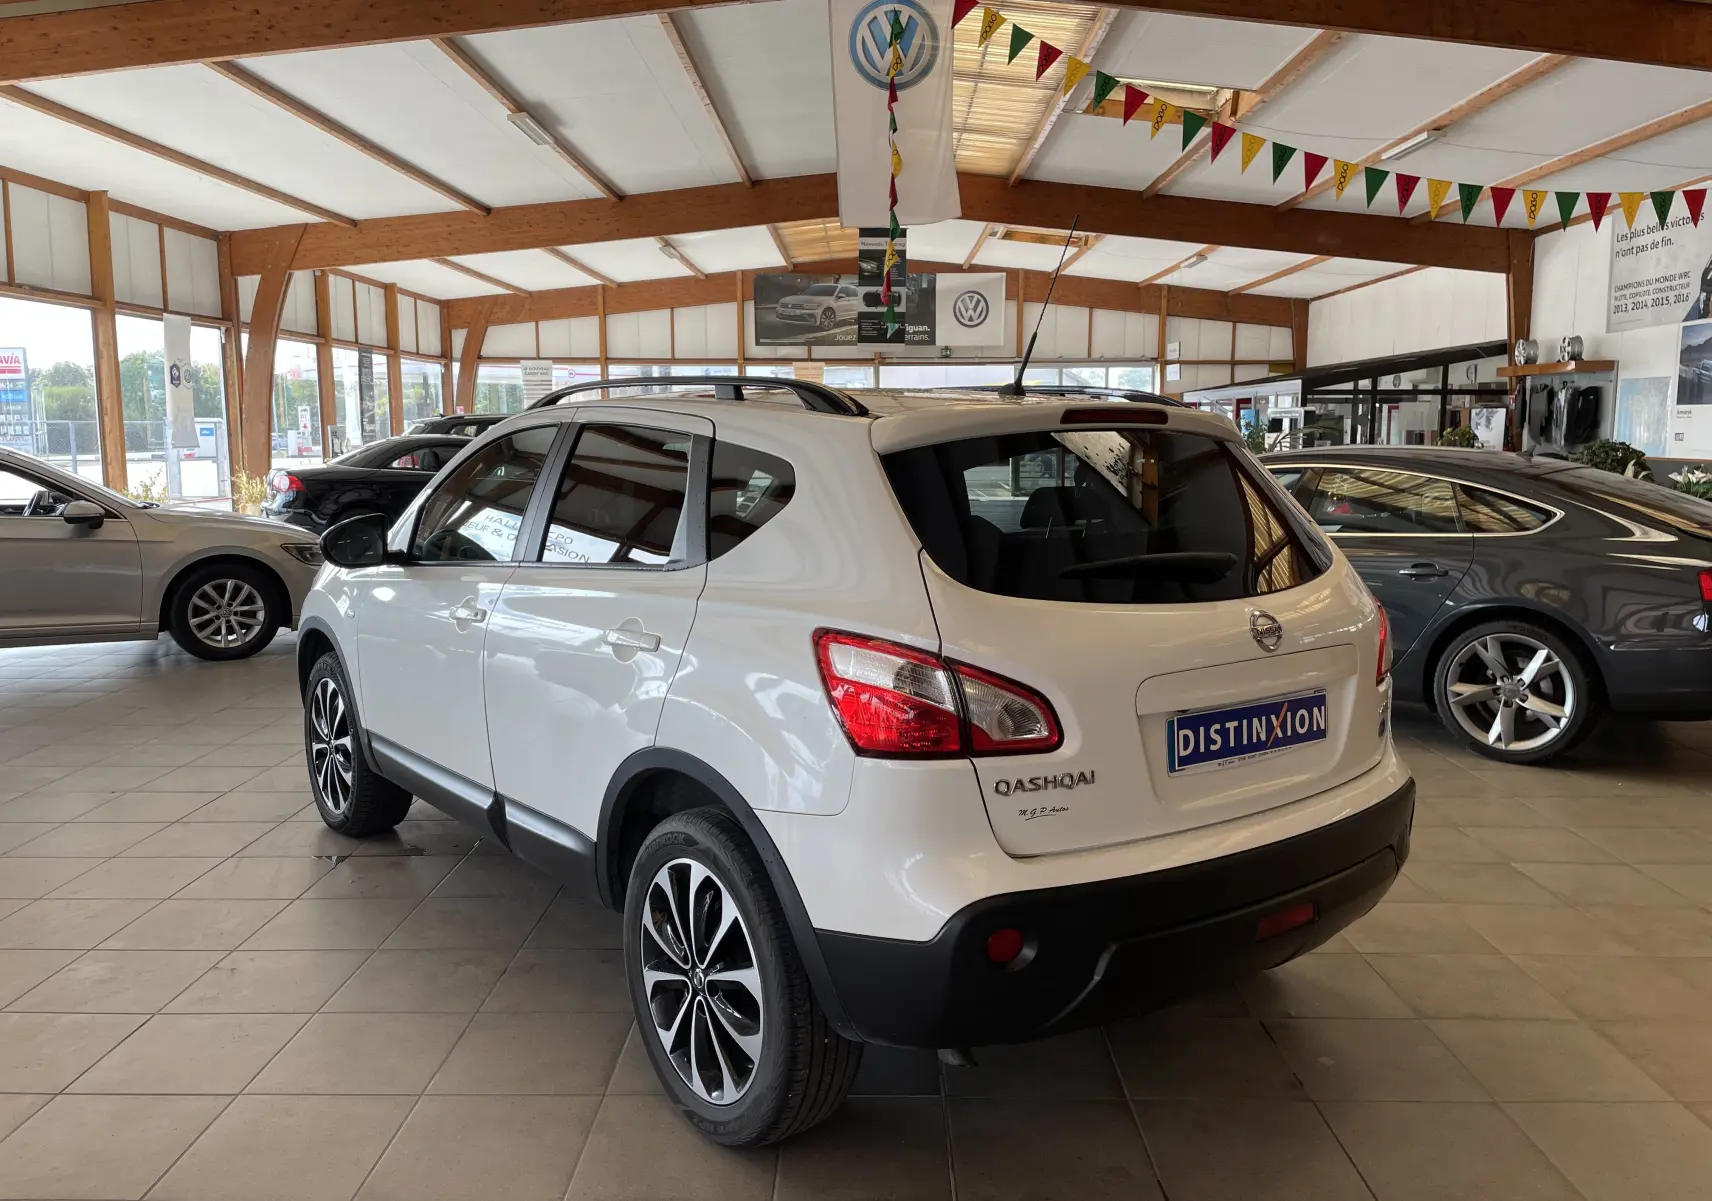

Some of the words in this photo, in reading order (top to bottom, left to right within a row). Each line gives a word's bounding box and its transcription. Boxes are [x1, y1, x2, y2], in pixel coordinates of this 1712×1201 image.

[1153, 103, 1168, 131] DOBO
[1337, 163, 1349, 191] DOBO
[1529, 192, 1538, 220] DOBO
[1616, 232, 1629, 243] Les
[1629, 228, 1645, 243] plus
[1646, 221, 1669, 235] bells
[1670, 212, 1705, 229] victos
[1635, 242, 1649, 256] pas
[1650, 239, 1660, 250] de
[1661, 236, 1675, 248] fin.
[1614, 281, 1645, 293] CHAMPIONS
[1646, 278, 1654, 287] DU
[1655, 273, 1677, 284] MONDE
[1677, 270, 1691, 280] WRC
[1652, 282, 1691, 295] CONSTRUCTEUR
[1613, 303, 1630, 315] 2013,
[1651, 296, 1672, 308] 2015,
[905, 323, 931, 333] iguan.
[905, 333, 931, 341] errains.
[1178, 702, 1326, 757] DISTINXION
[993, 770, 1095, 797] QASHQAI
[1048, 806, 1070, 814] Autos
